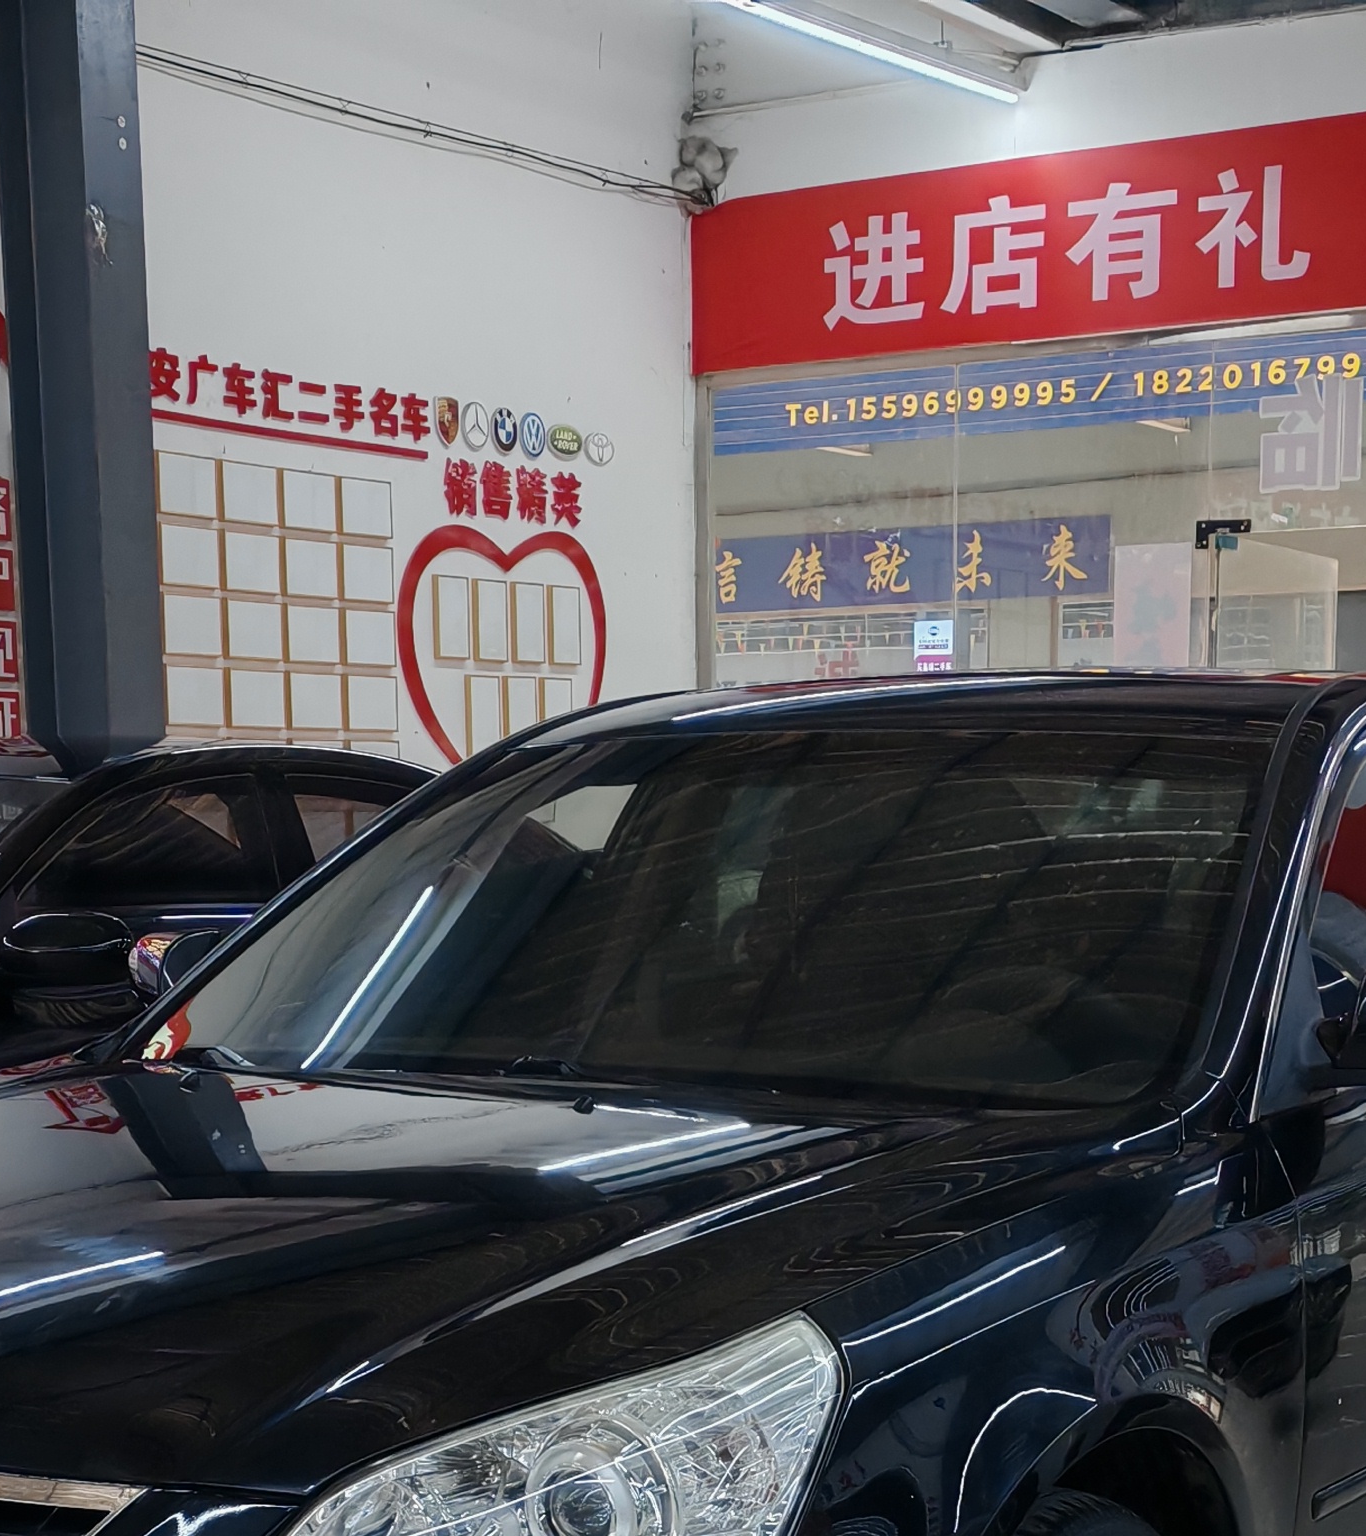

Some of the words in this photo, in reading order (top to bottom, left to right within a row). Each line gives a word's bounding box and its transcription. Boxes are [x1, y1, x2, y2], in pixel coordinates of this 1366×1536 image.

[822, 164, 1312, 331] 进店有礼
[443, 456, 583, 528] 销售精英
